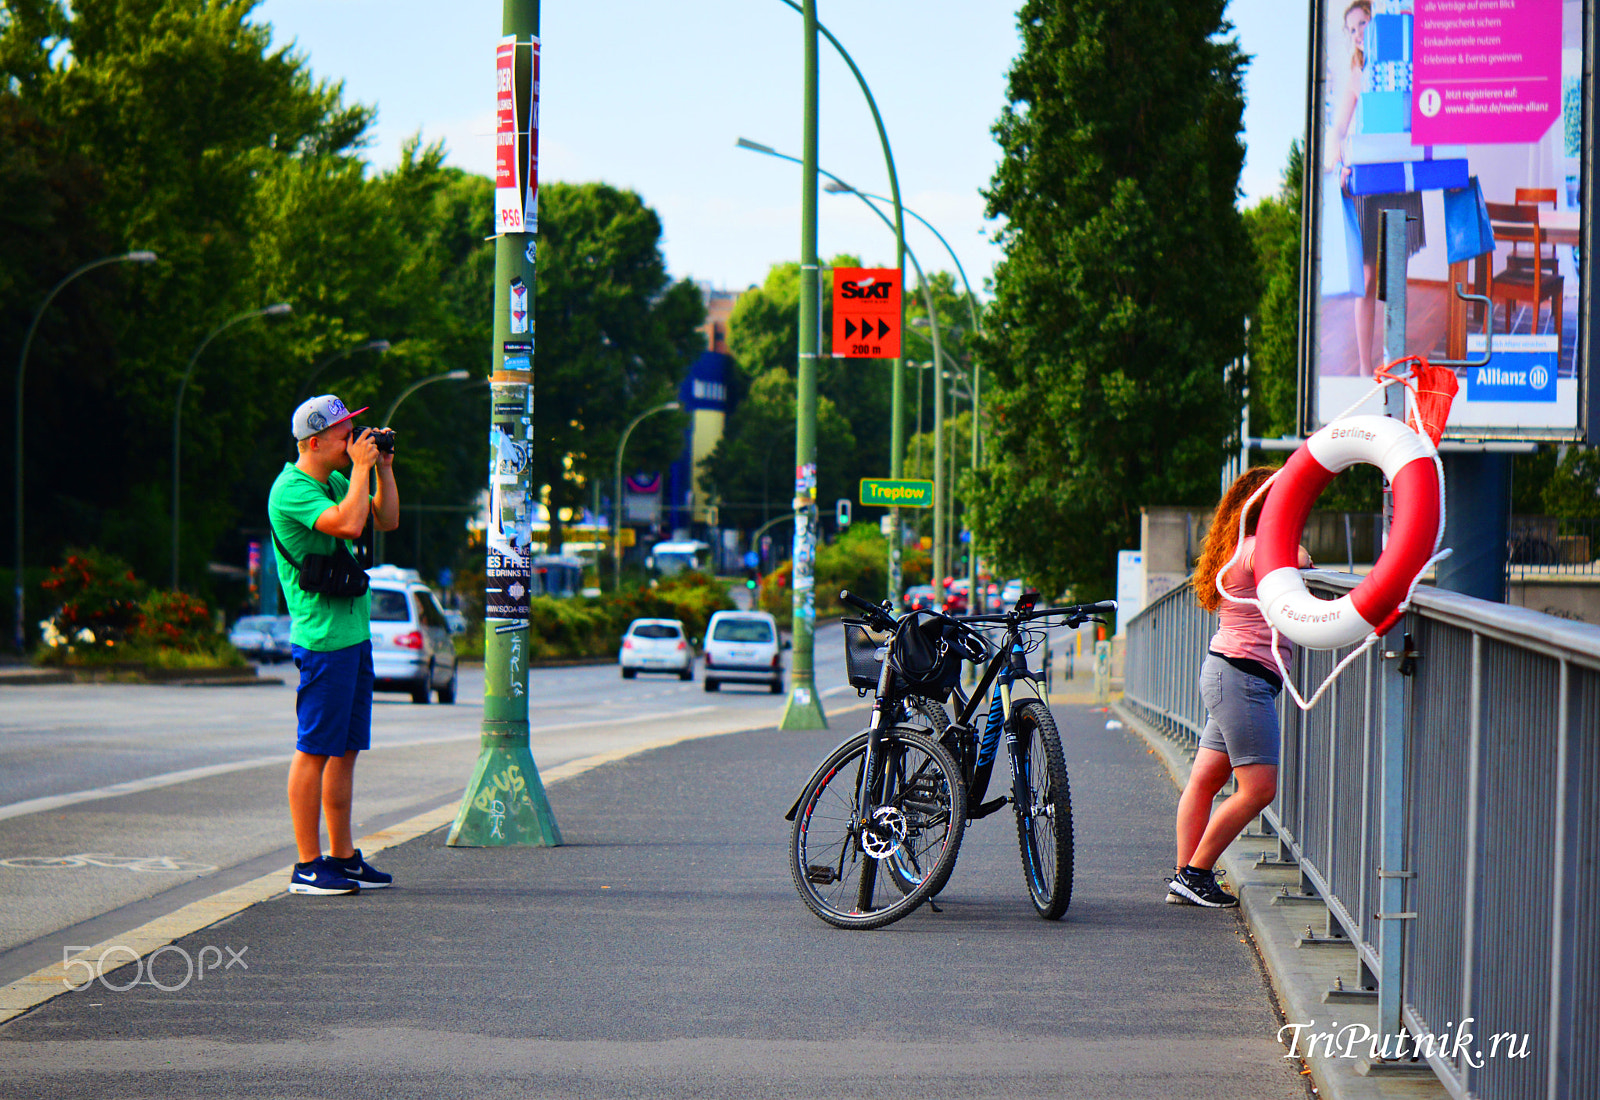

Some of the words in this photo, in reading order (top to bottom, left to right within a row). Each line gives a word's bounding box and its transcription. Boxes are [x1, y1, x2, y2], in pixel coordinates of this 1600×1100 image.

[1479, 1, 1499, 10] einen
[1424, 18, 1476, 31] Jahresgeschenk
[1476, 17, 1502, 28] sichern
[1476, 35, 1501, 46] nutzen
[1423, 53, 1457, 65] Erlebnisse
[1457, 53, 1464, 64] &
[1465, 53, 1488, 64] Events
[1488, 53, 1523, 66] gewinnen
[1445, 88, 1461, 100] Jetzt
[1462, 88, 1503, 101] registrieren
[1445, 101, 1549, 115] www.allianz.de/meine-allianz
[502, 209, 520, 227] PSG
[852, 344, 870, 354] 200
[872, 346, 881, 354] m
[1476, 367, 1527, 386] Allianz
[1331, 427, 1377, 441] Berliner
[869, 483, 926, 501] Treptow
[496, 569, 522, 577] DRINKS
[1280, 604, 1342, 623] Feuerwehr
